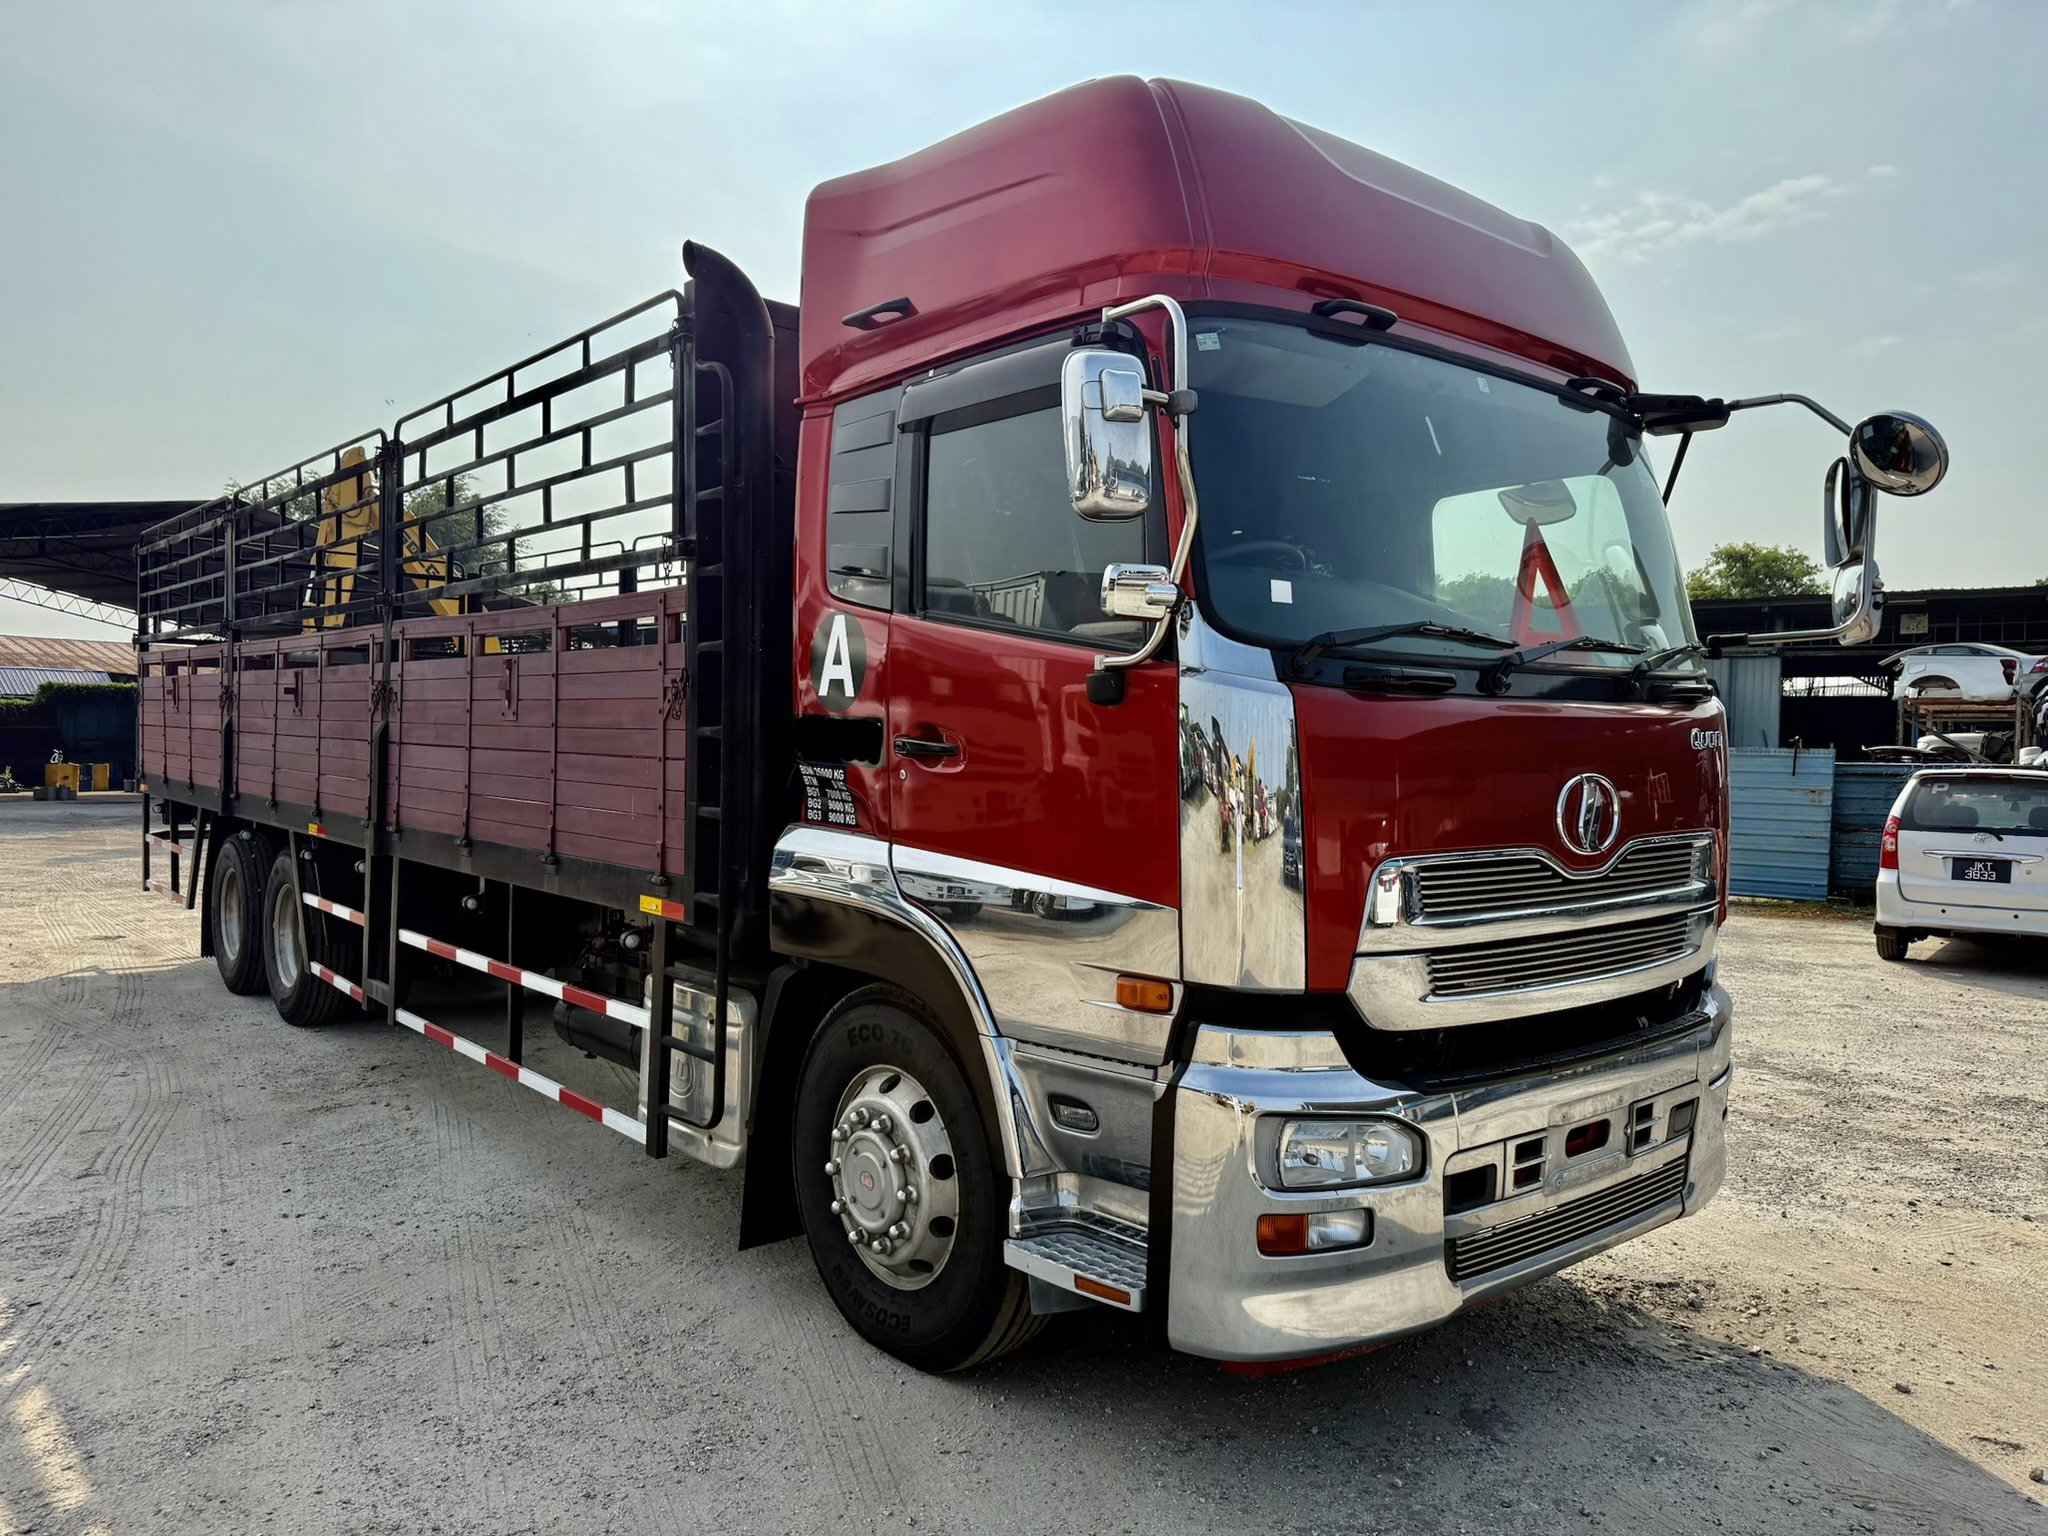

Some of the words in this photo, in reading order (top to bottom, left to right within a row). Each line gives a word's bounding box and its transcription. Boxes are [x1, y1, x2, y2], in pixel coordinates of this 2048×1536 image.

[818, 614, 855, 697] A
[1690, 727, 1723, 749] Quon
[803, 775, 819, 786] BTM
[833, 769, 844, 780] KG
[806, 786, 820, 797] BG1
[825, 788, 841, 800] 7000
[841, 791, 852, 802] KG
[1931, 783, 1949, 794] P
[807, 797, 822, 809] BG2
[828, 800, 844, 811] 9000
[844, 802, 855, 813] KG
[807, 809, 822, 821] BG3
[828, 812, 844, 823] 9000
[845, 814, 856, 825] KG
[1970, 861, 1993, 871] JKT
[1964, 869, 1996, 881] 3833
[847, 1023, 883, 1048] ECO
